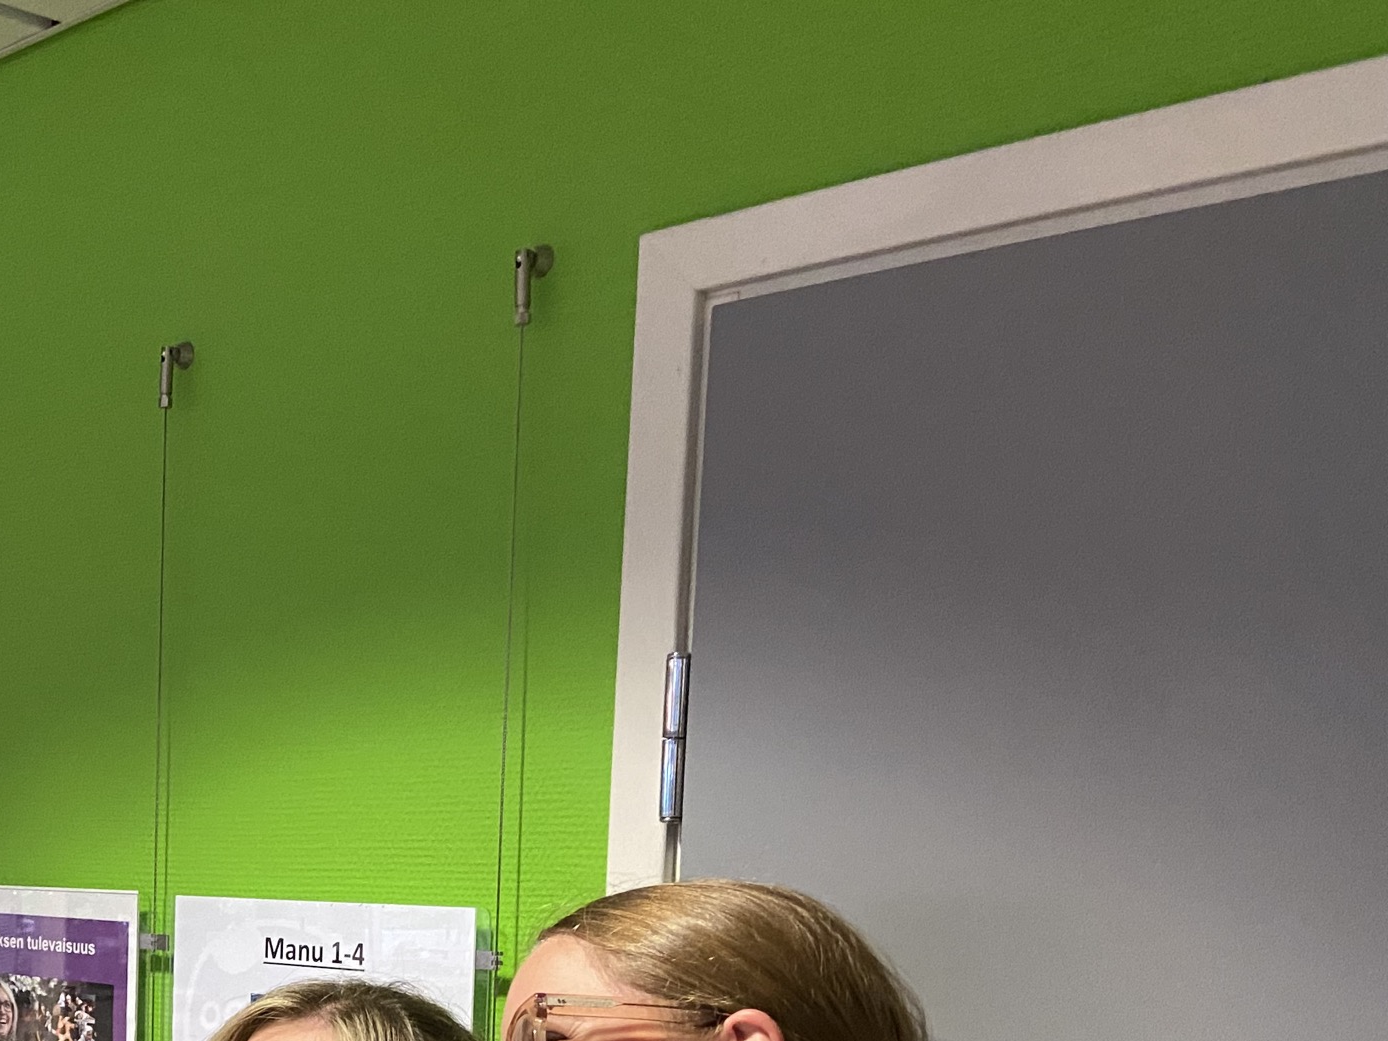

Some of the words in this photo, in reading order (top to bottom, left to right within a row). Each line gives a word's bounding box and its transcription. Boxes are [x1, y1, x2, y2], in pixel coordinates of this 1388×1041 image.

[27, 936, 96, 955] tulevaisuus
[264, 937, 324, 963] Manu
[331, 941, 365, 966] 1-4
